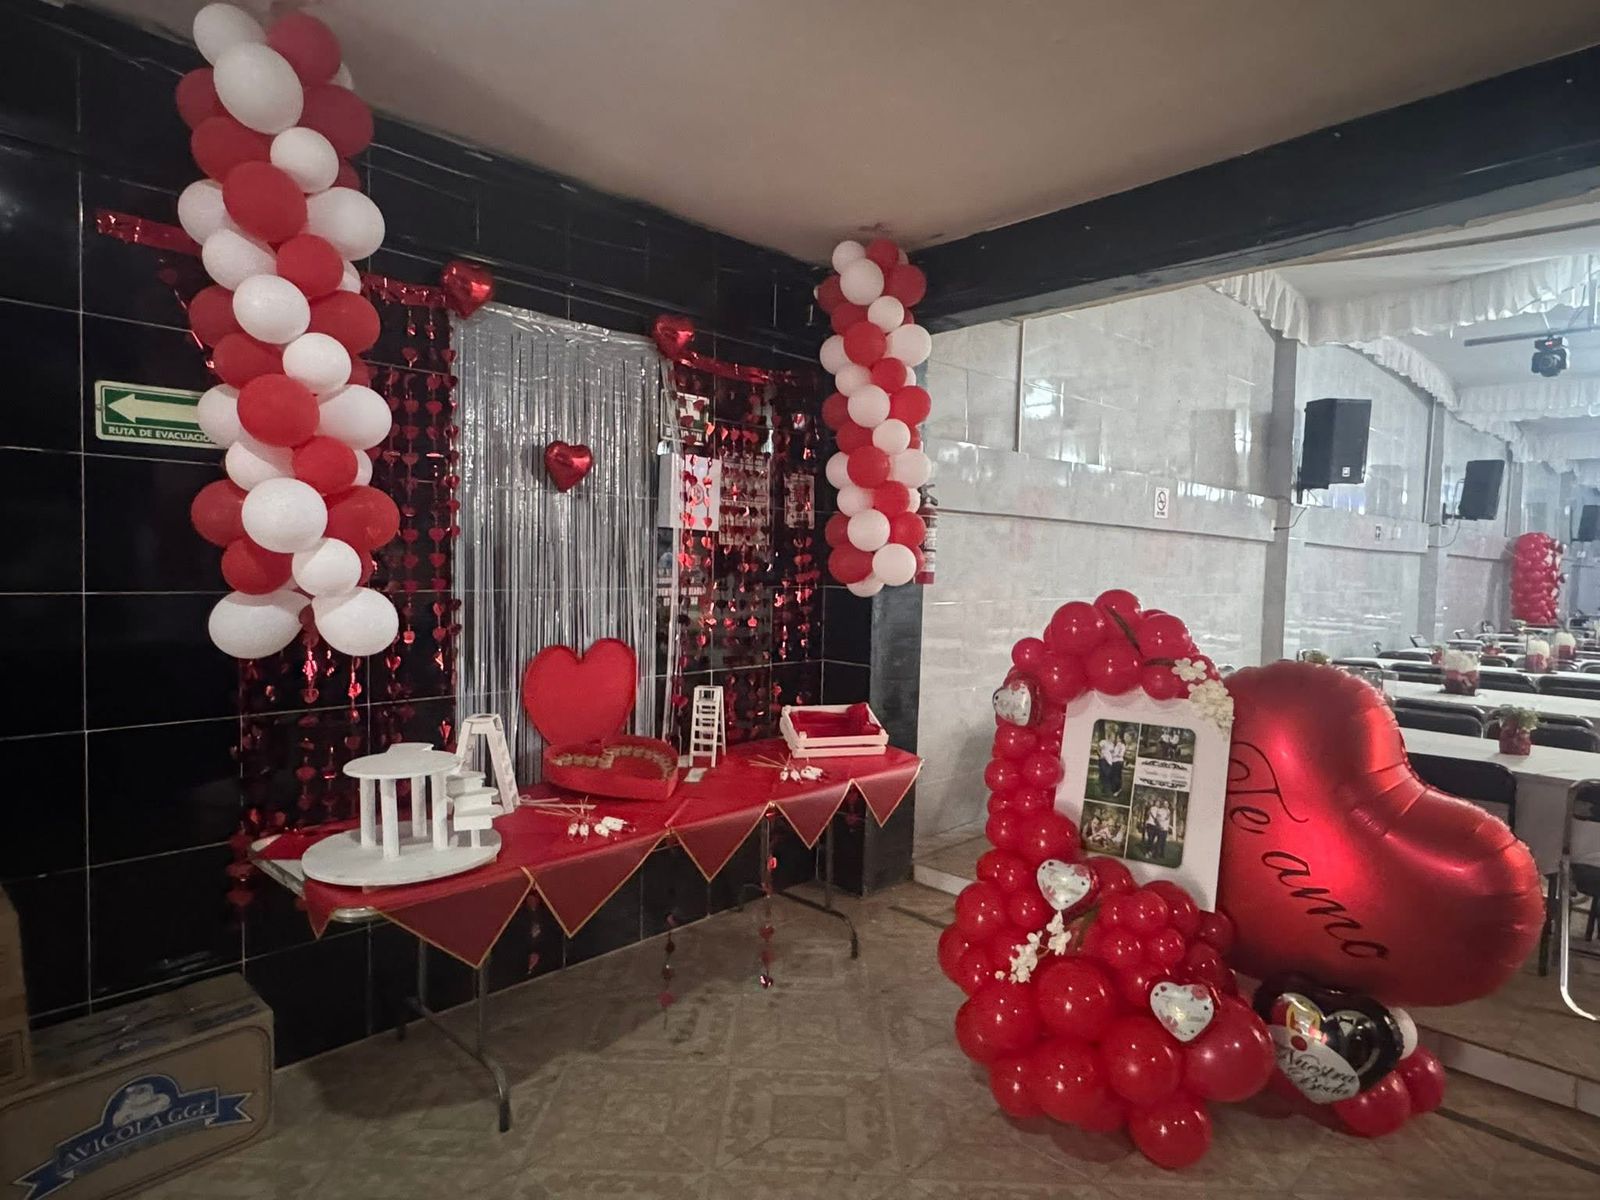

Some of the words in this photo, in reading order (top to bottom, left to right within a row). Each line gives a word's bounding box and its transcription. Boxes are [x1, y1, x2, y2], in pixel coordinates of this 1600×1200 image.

[108, 426, 136, 436] RUTA
[140, 428, 152, 437] DE
[155, 430, 211, 442] EVACUACIO
[1261, 851, 1390, 958] amo
